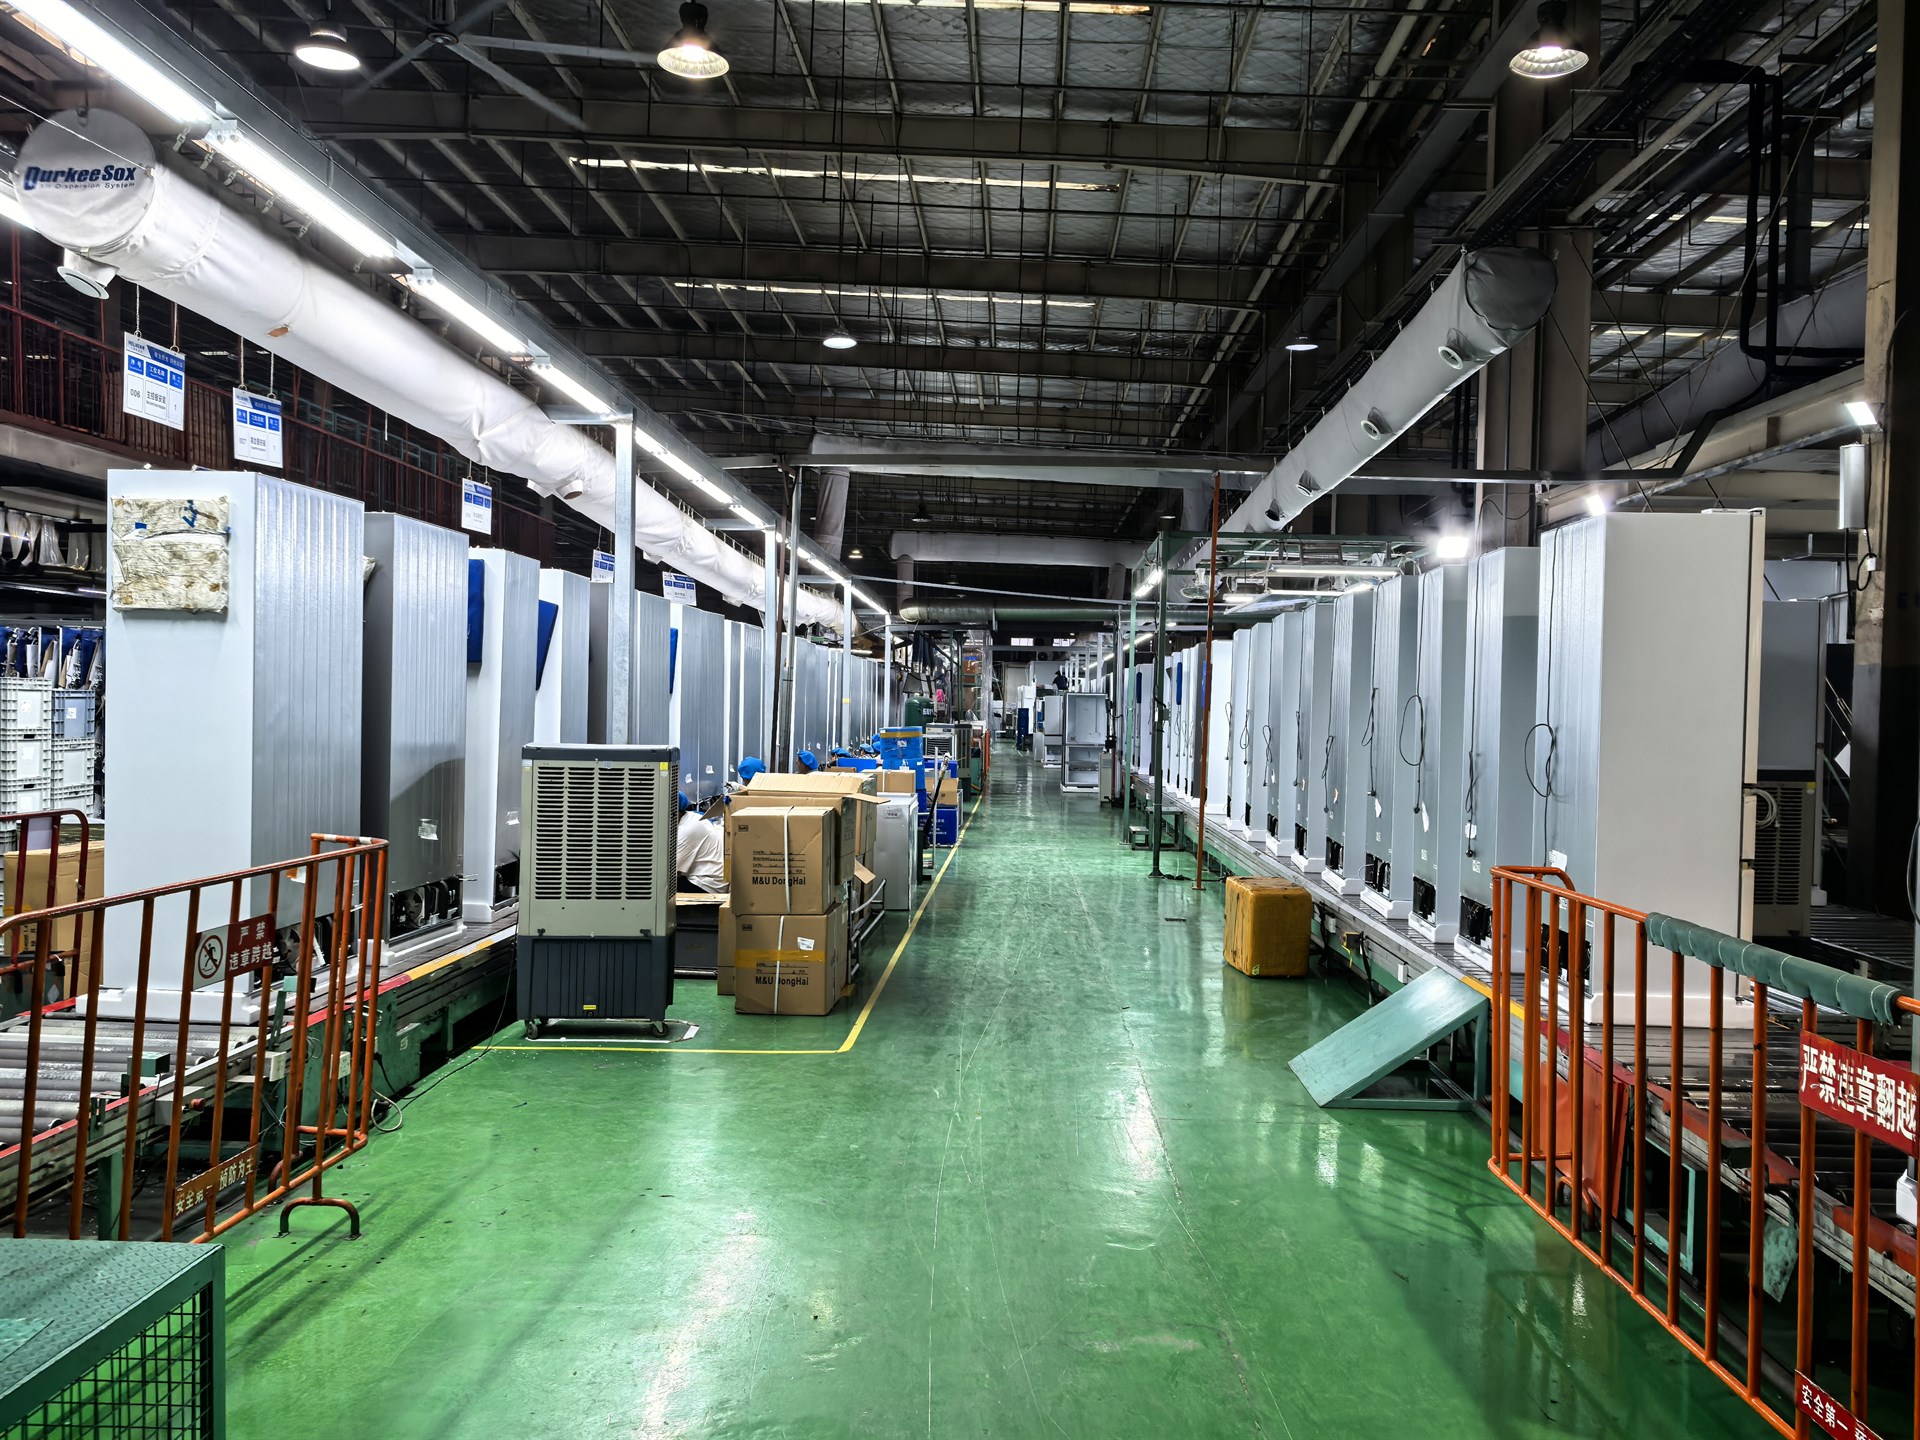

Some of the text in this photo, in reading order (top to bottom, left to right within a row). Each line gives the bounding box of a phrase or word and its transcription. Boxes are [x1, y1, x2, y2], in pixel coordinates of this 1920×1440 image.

[104, 182, 135, 190] System
[752, 876, 770, 885] M&U
[239, 921, 266, 945] 严禁
[229, 941, 272, 971] 违章跨越
[755, 976, 774, 985] M&U
[1801, 1044, 1917, 1142] 严禁违章翻越
[1801, 1384, 1849, 1431] 安全第一
